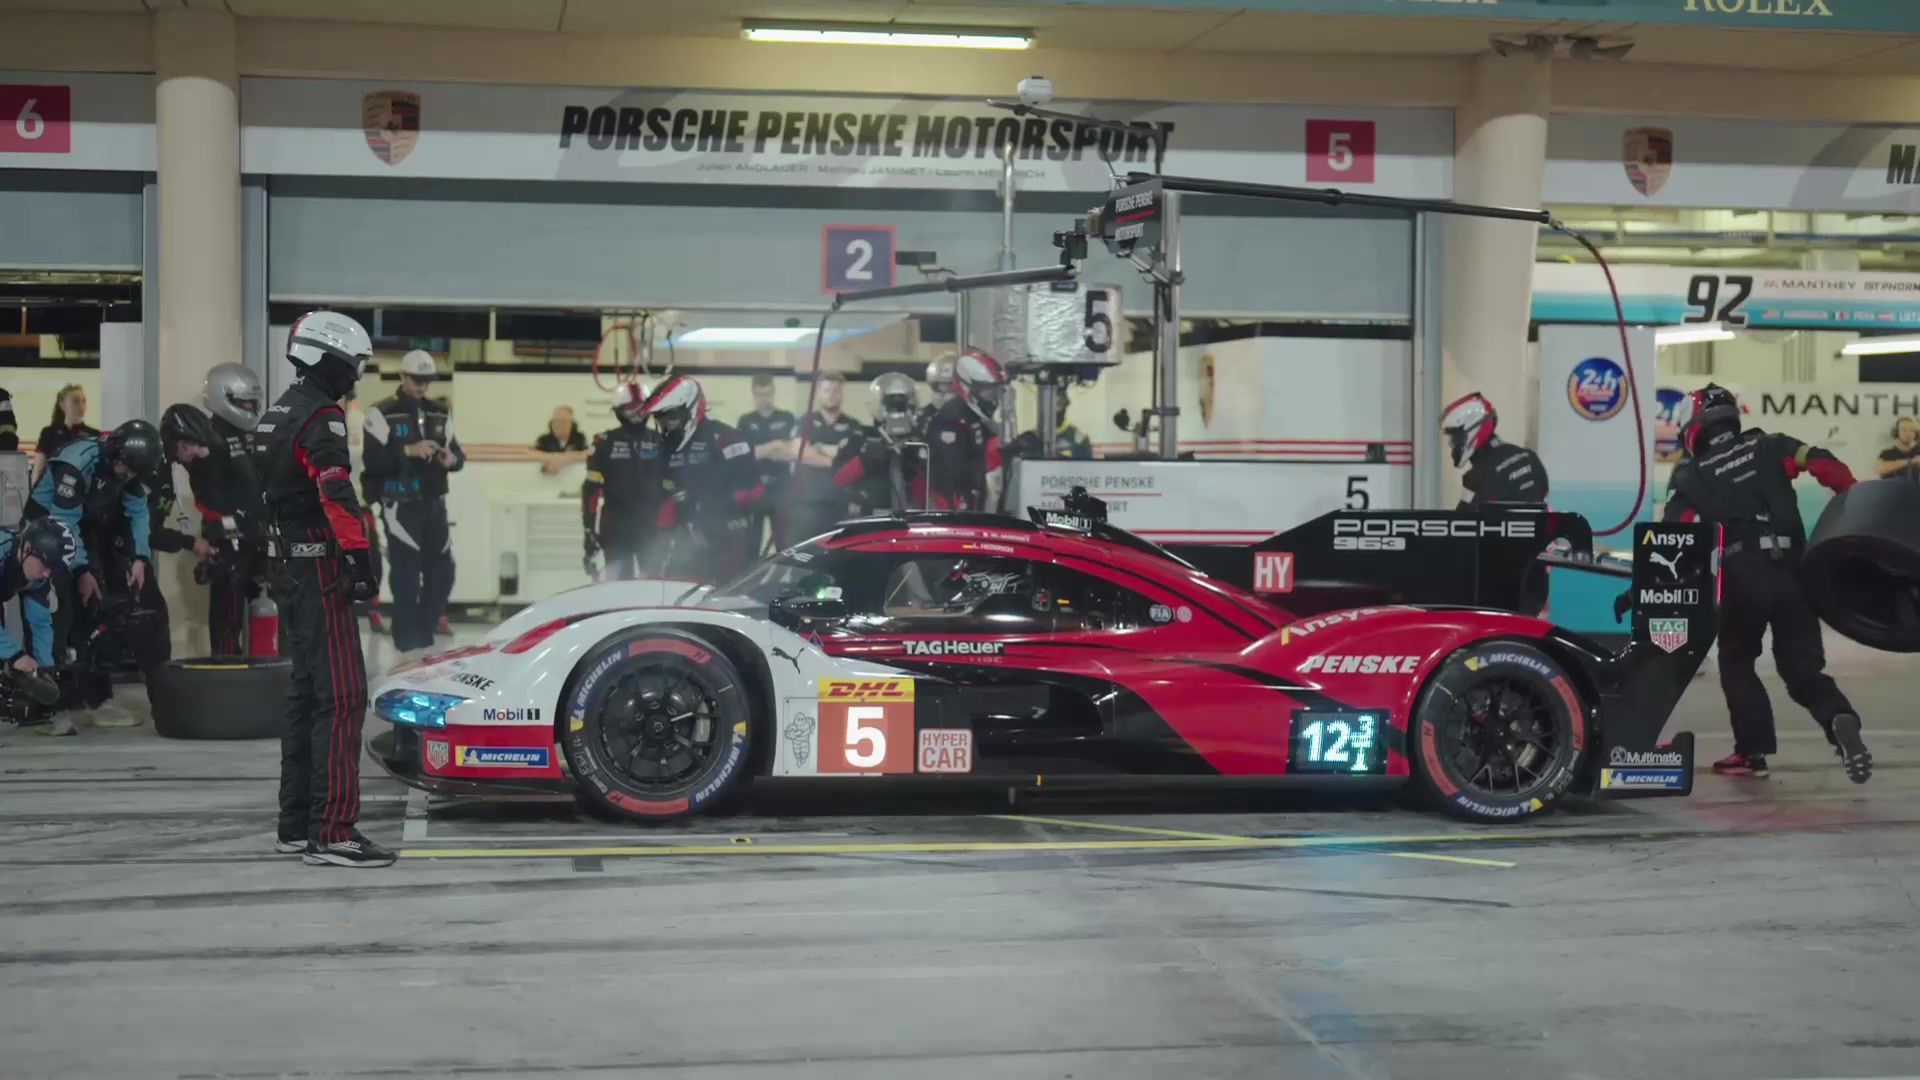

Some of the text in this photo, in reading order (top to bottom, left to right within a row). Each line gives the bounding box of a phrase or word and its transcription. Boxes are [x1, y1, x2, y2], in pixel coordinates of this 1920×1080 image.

[16, 98, 44, 140] 6
[559, 105, 1175, 164] PORSCHE PENSKE MOTORSPORT
[1327, 132, 1354, 172] 5
[1886, 143, 1920, 185] M
[845, 238, 873, 280] 2
[1781, 279, 1856, 290] MANTHEY
[1684, 274, 1753, 324] 92
[1084, 290, 1113, 353] 5
[1041, 476, 1155, 488] PORSCHE PENSKE
[1346, 476, 1369, 510] 5
[1046, 512, 1079, 527] Mobil
[1333, 519, 1535, 537] PORSCHE
[1333, 537, 1406, 550] 963
[1642, 529, 1694, 548] Ansys
[1254, 555, 1292, 590] HY
[1640, 589, 1682, 604] Mobil
[1281, 608, 1380, 646] Ansys
[1652, 621, 1685, 632] TAG
[1299, 655, 1421, 674] PENSKE
[1489, 652, 1551, 676] MICHELIN
[576, 650, 623, 707] MICHELIN
[828, 682, 904, 697] DHL
[483, 708, 524, 721] Mobil
[844, 705, 887, 768] 5
[922, 732, 967, 747] HYPER
[1303, 719, 1350, 762] 12
[430, 743, 448, 752] TAG
[480, 753, 540, 761] MICHELIN
[921, 747, 967, 769] CAR
[1627, 751, 1682, 764] Multimatic
[695, 745, 741, 804] MICHELIN
[1625, 775, 1679, 784] MICHELIN
[1456, 796, 1519, 817] MICHELIN
